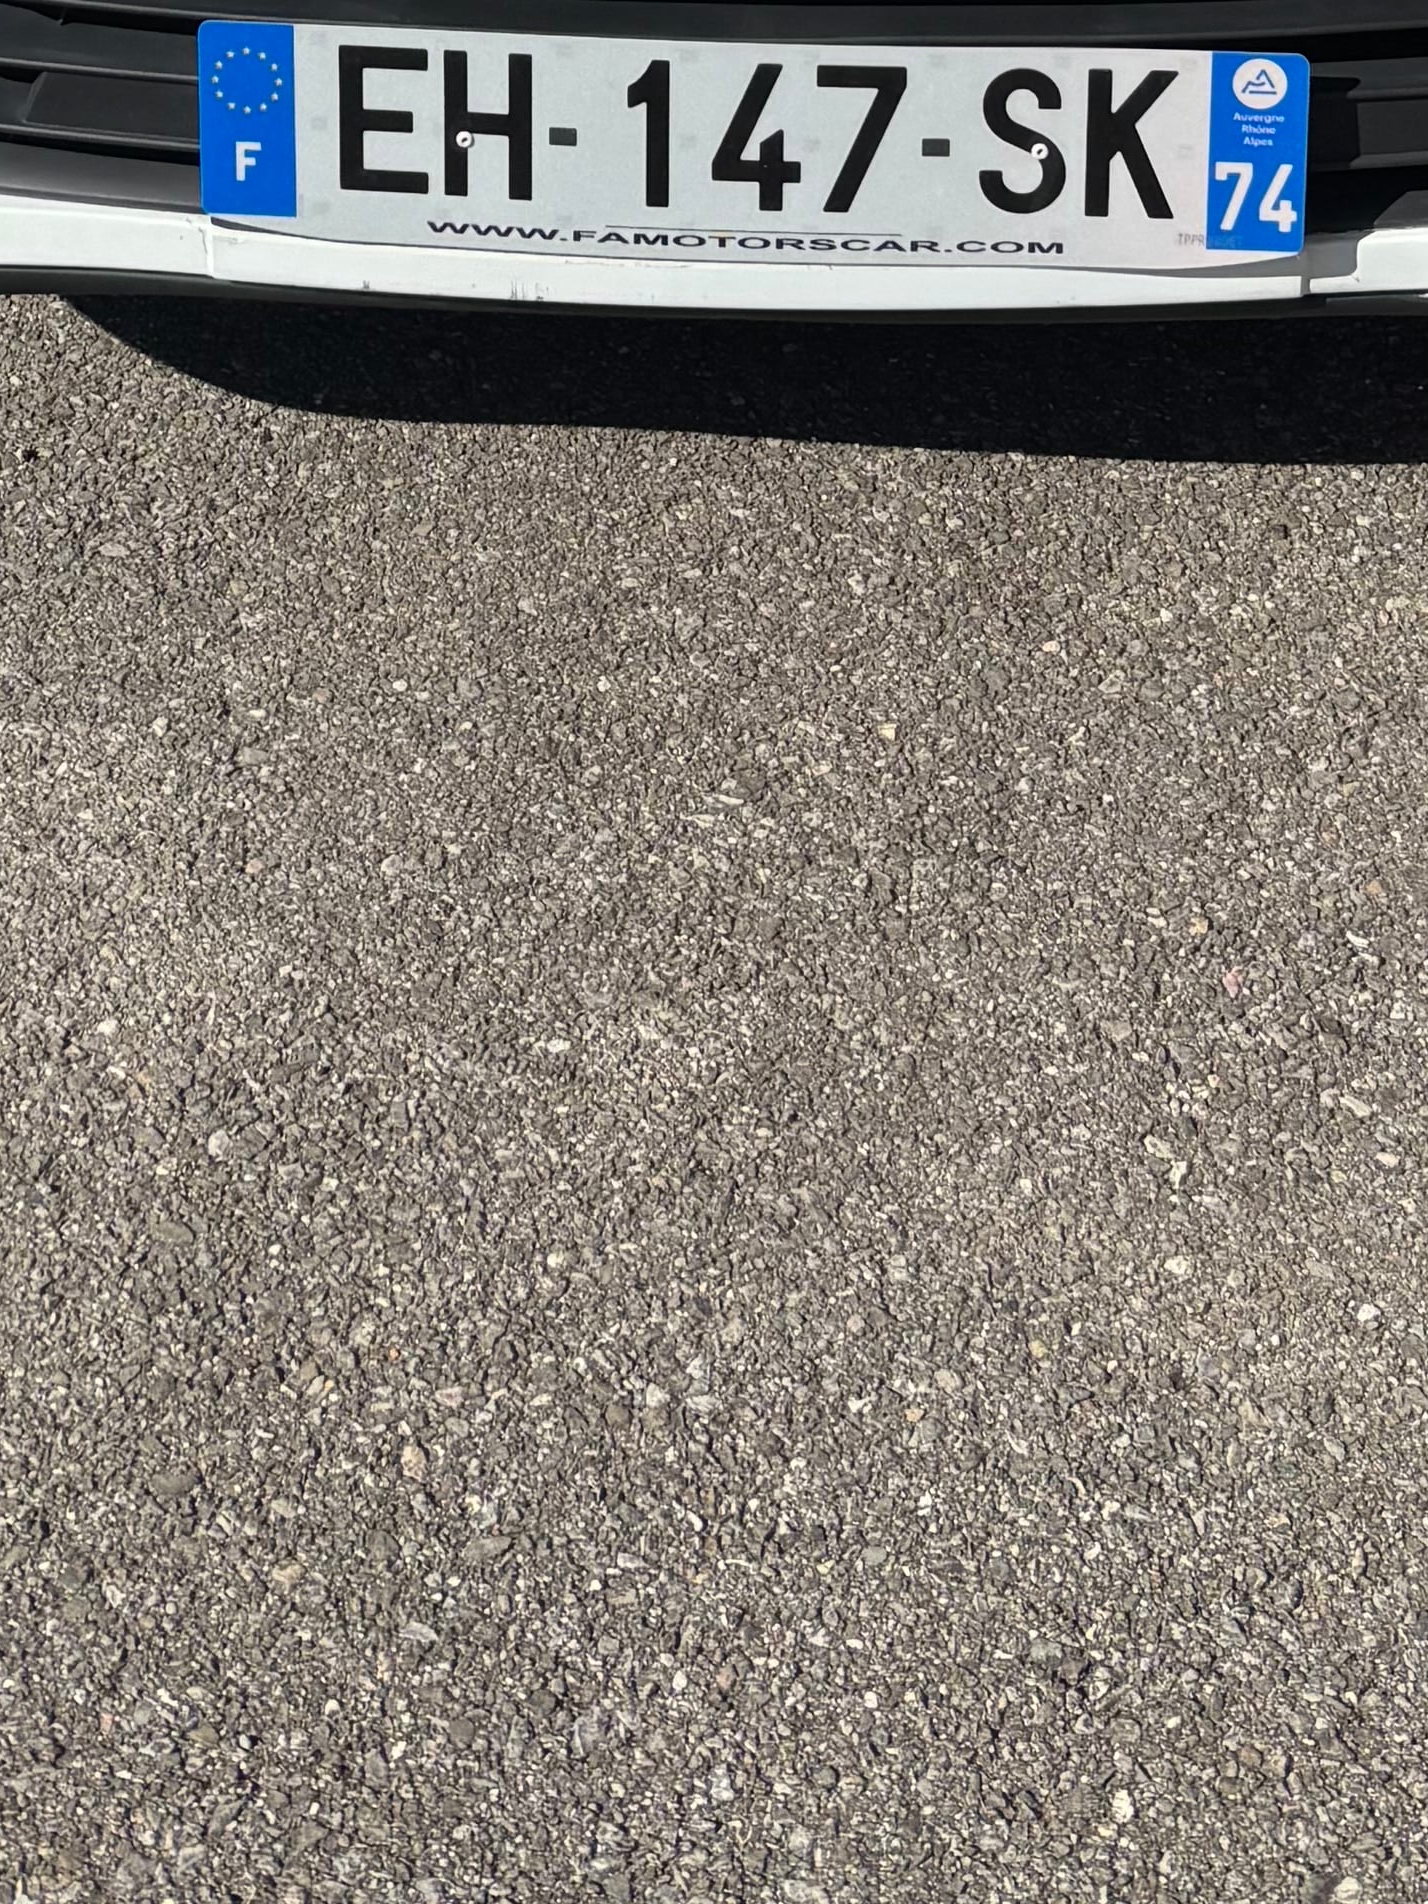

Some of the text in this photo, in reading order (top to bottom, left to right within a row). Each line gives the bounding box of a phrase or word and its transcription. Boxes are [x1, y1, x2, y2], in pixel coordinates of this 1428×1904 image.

[338, 44, 1180, 219] EH-147-SK
[1232, 111, 1285, 124] Auvergne
[1243, 136, 1274, 148] Alpes
[235, 141, 262, 182] F
[1215, 161, 1297, 233] 74
[427, 221, 1064, 254] WWW.FAMOTORSCAR.COM
